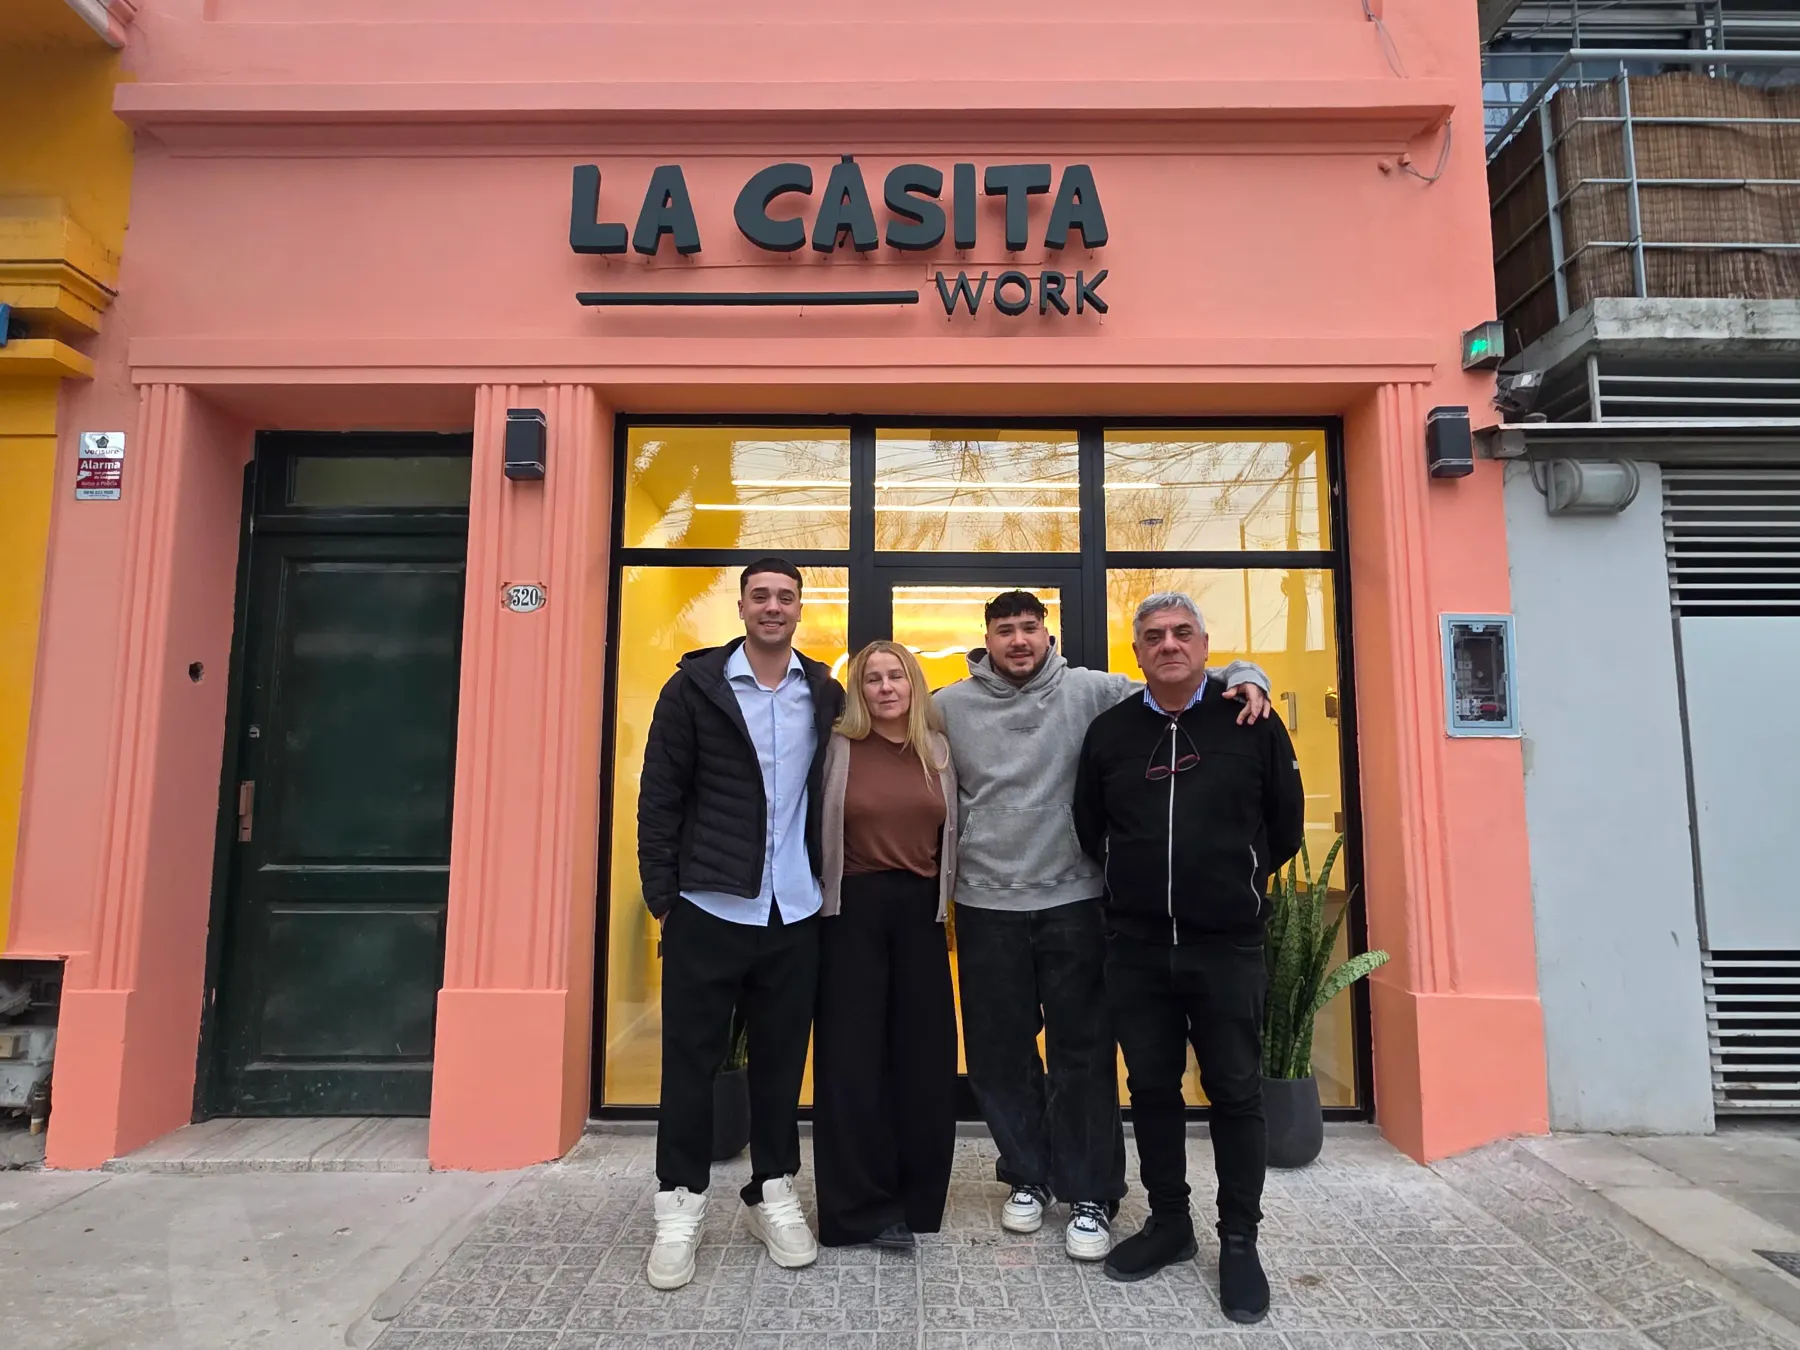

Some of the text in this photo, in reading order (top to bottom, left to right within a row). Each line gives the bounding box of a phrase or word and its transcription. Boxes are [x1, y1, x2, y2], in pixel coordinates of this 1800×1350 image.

[570, 158, 1108, 254] LA CASITA
[937, 270, 1108, 315] WORK
[81, 460, 120, 469] Alarma
[512, 588, 538, 606] 320
